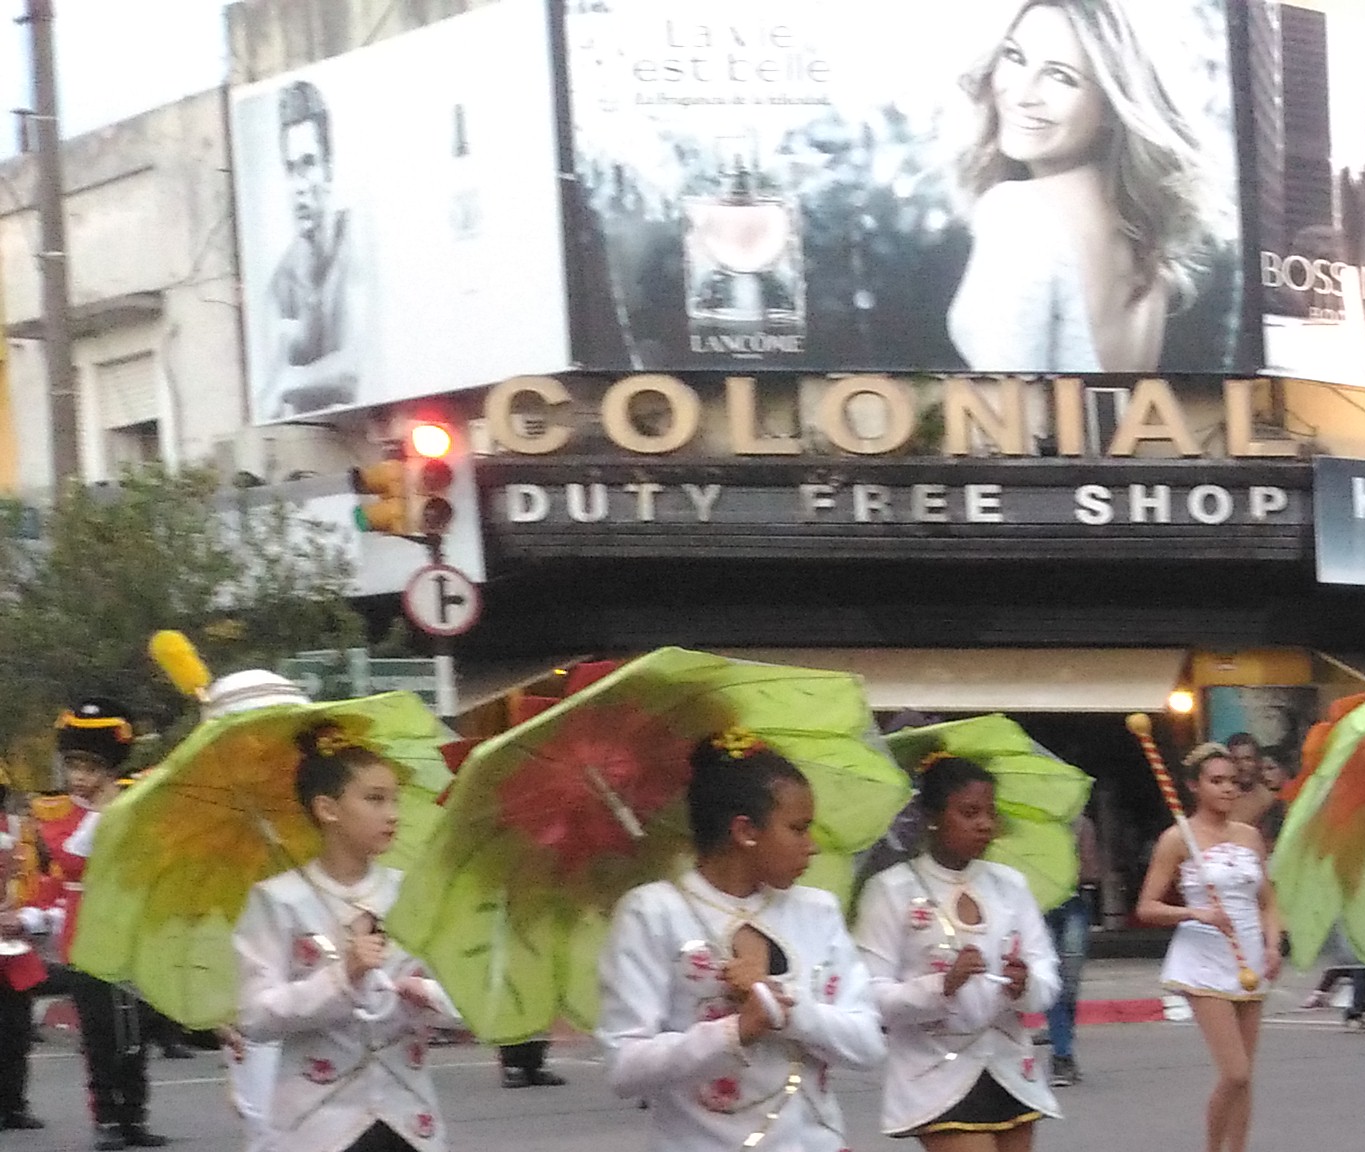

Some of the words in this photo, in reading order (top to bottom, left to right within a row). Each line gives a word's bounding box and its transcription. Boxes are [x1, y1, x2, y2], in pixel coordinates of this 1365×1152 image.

[1260, 251, 1348, 298] BOSS
[485, 374, 1300, 457] COLONIAL
[504, 483, 722, 523] DUTY
[801, 484, 1004, 524] FREE
[1074, 484, 1289, 525] SHOP
